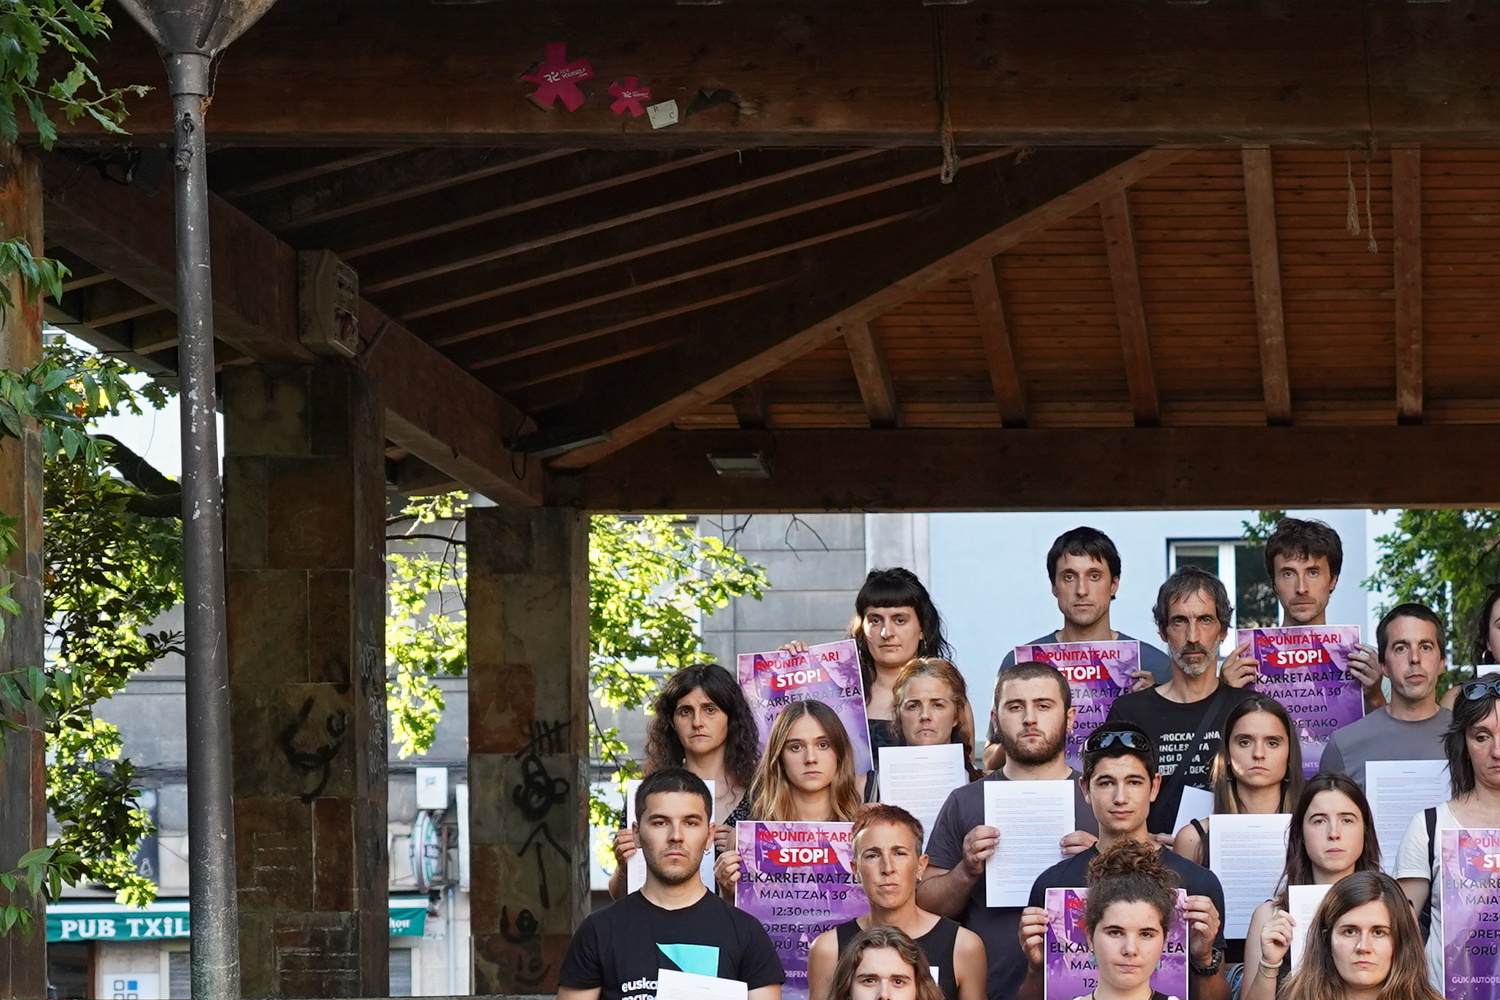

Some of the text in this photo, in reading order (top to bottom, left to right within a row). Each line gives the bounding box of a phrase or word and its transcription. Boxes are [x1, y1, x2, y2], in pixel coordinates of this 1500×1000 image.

[1278, 650, 1322, 665] STOP!
[777, 669, 821, 687] STOP!
[1328, 688, 1341, 696] 30
[779, 849, 829, 863] STOP!
[741, 873, 862, 884] ELKARRETARATZE
[760, 891, 847, 900] MAIATZAK 30
[772, 907, 830, 916] 12:30etan
[60, 917, 190, 939] PUB TXiL
[1452, 976, 1469, 984] GUK
